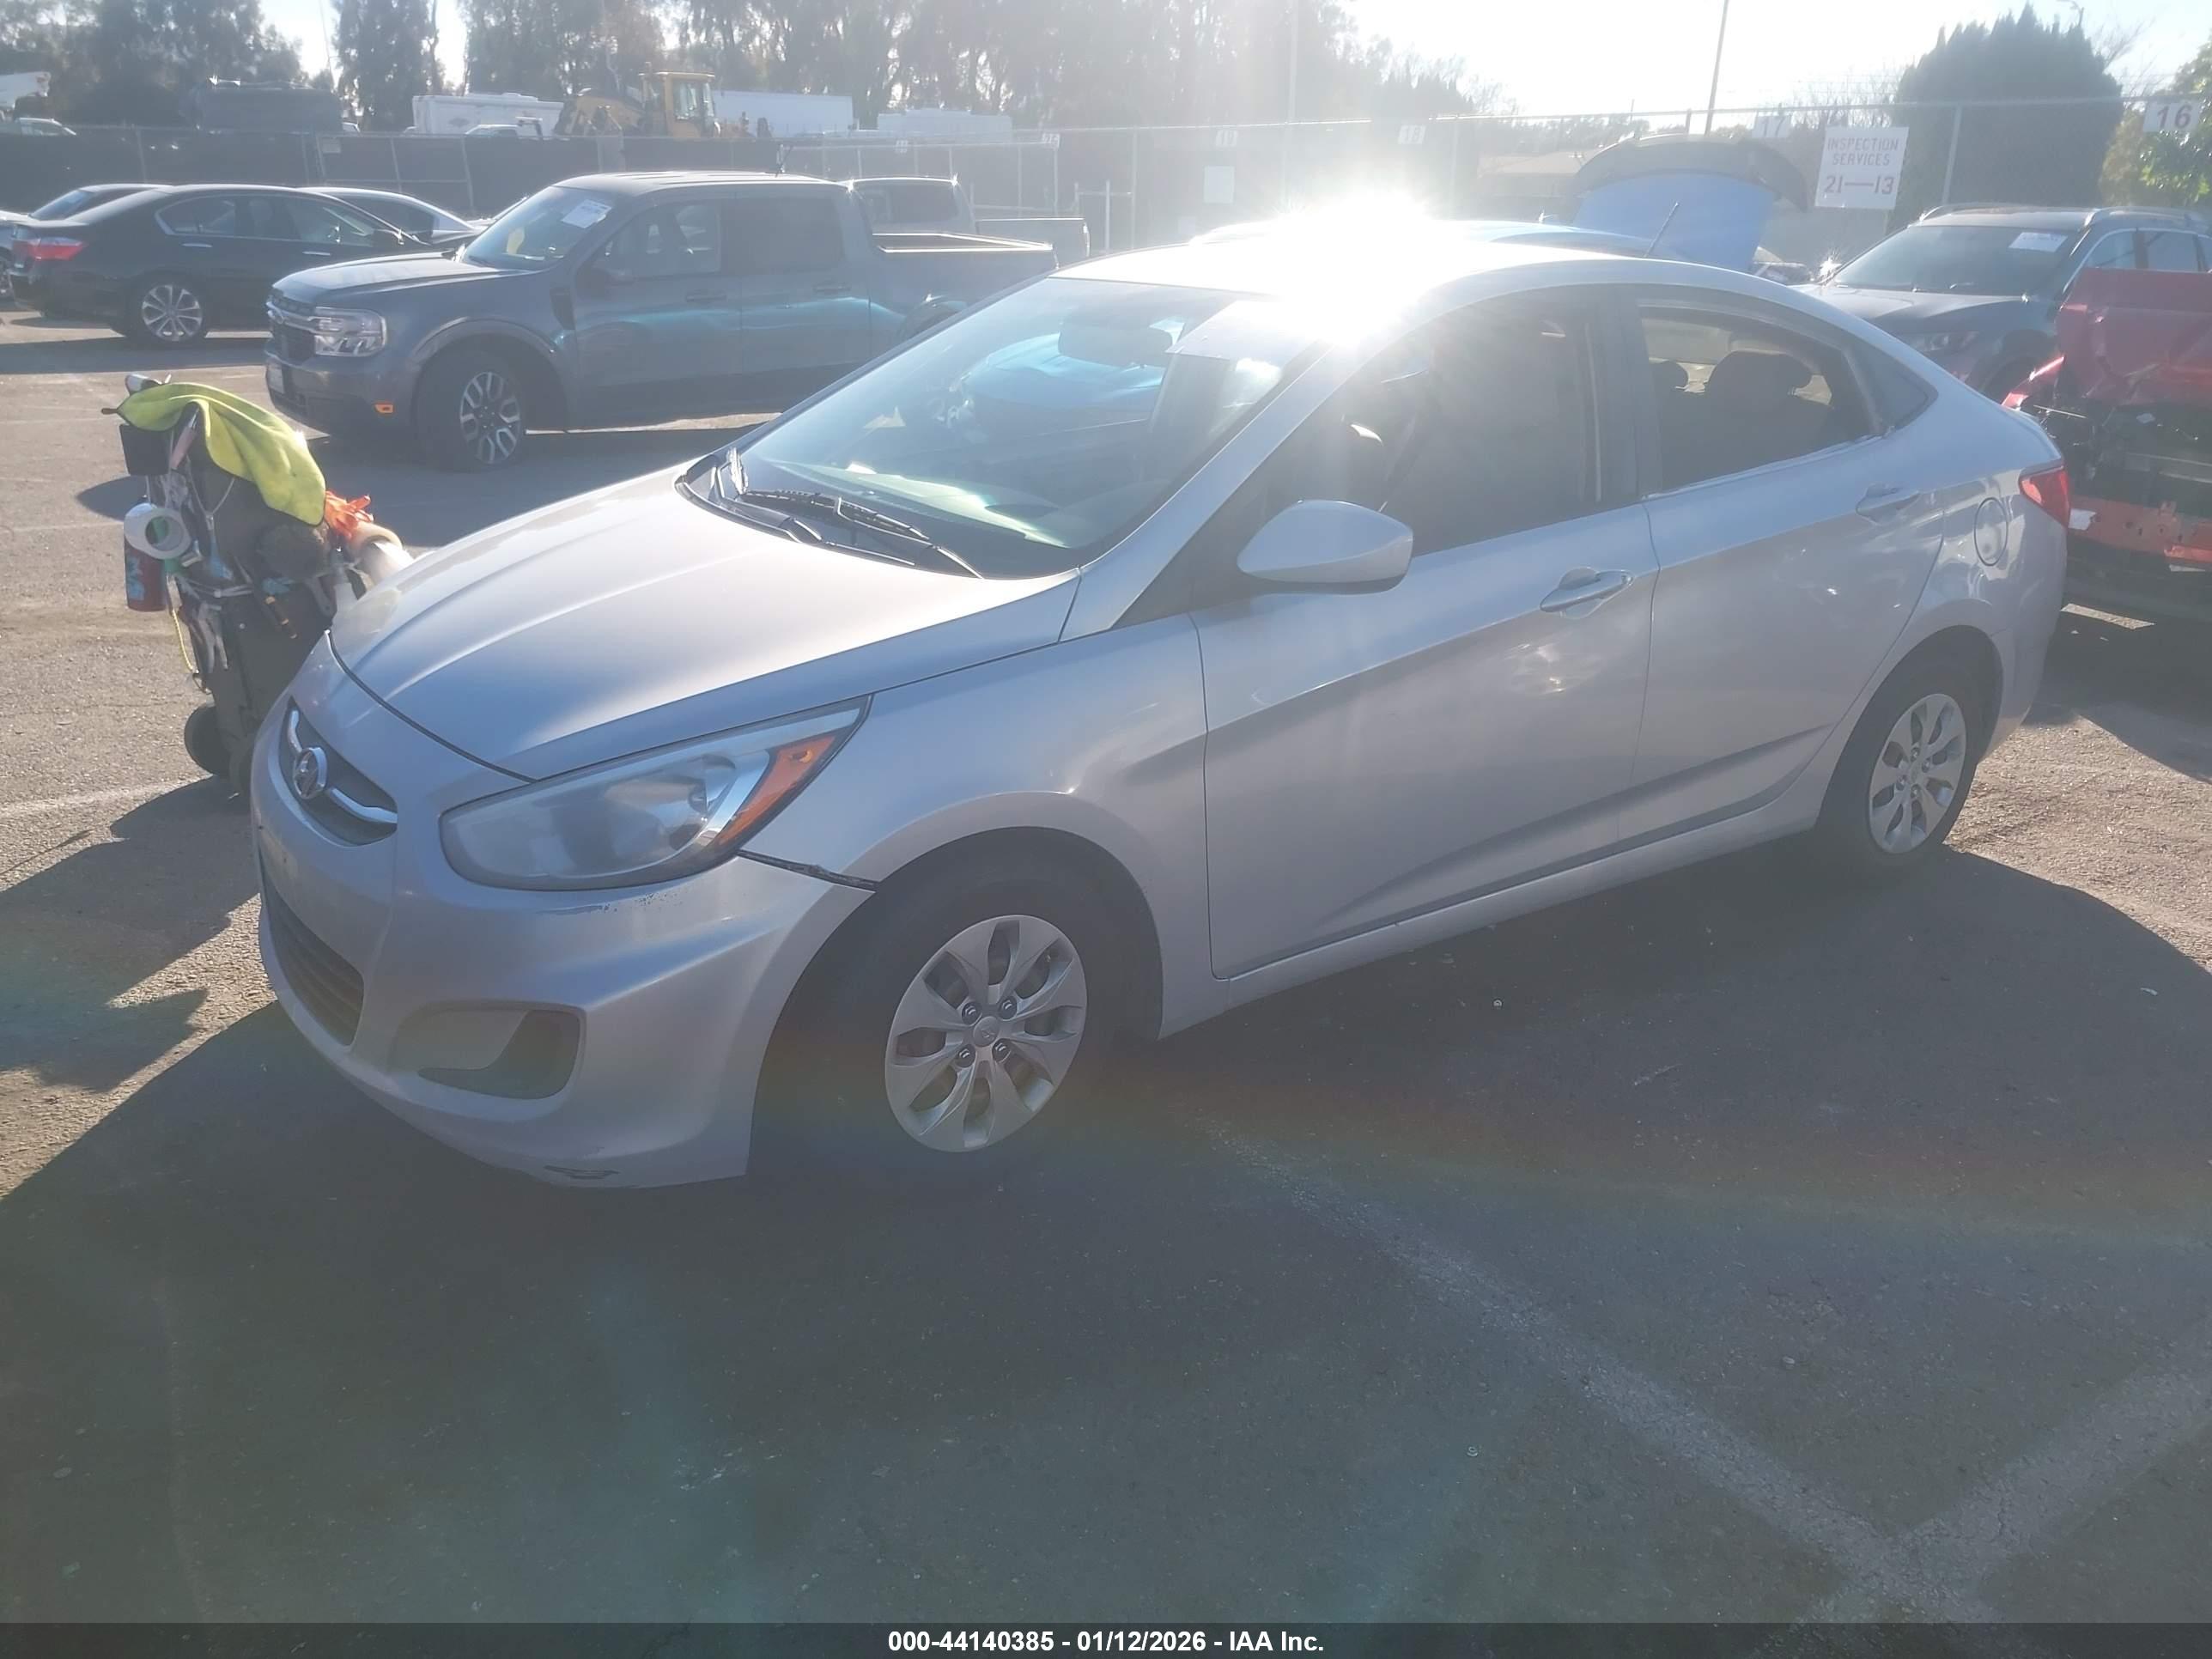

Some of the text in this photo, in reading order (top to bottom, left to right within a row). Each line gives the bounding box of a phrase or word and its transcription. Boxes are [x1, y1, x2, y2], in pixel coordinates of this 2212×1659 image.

[2157, 104, 2193, 129] 16
[1761, 116, 1787, 137] 17
[1826, 137, 1899, 152] INSPECTION
[1832, 152, 1891, 167] SERVICES
